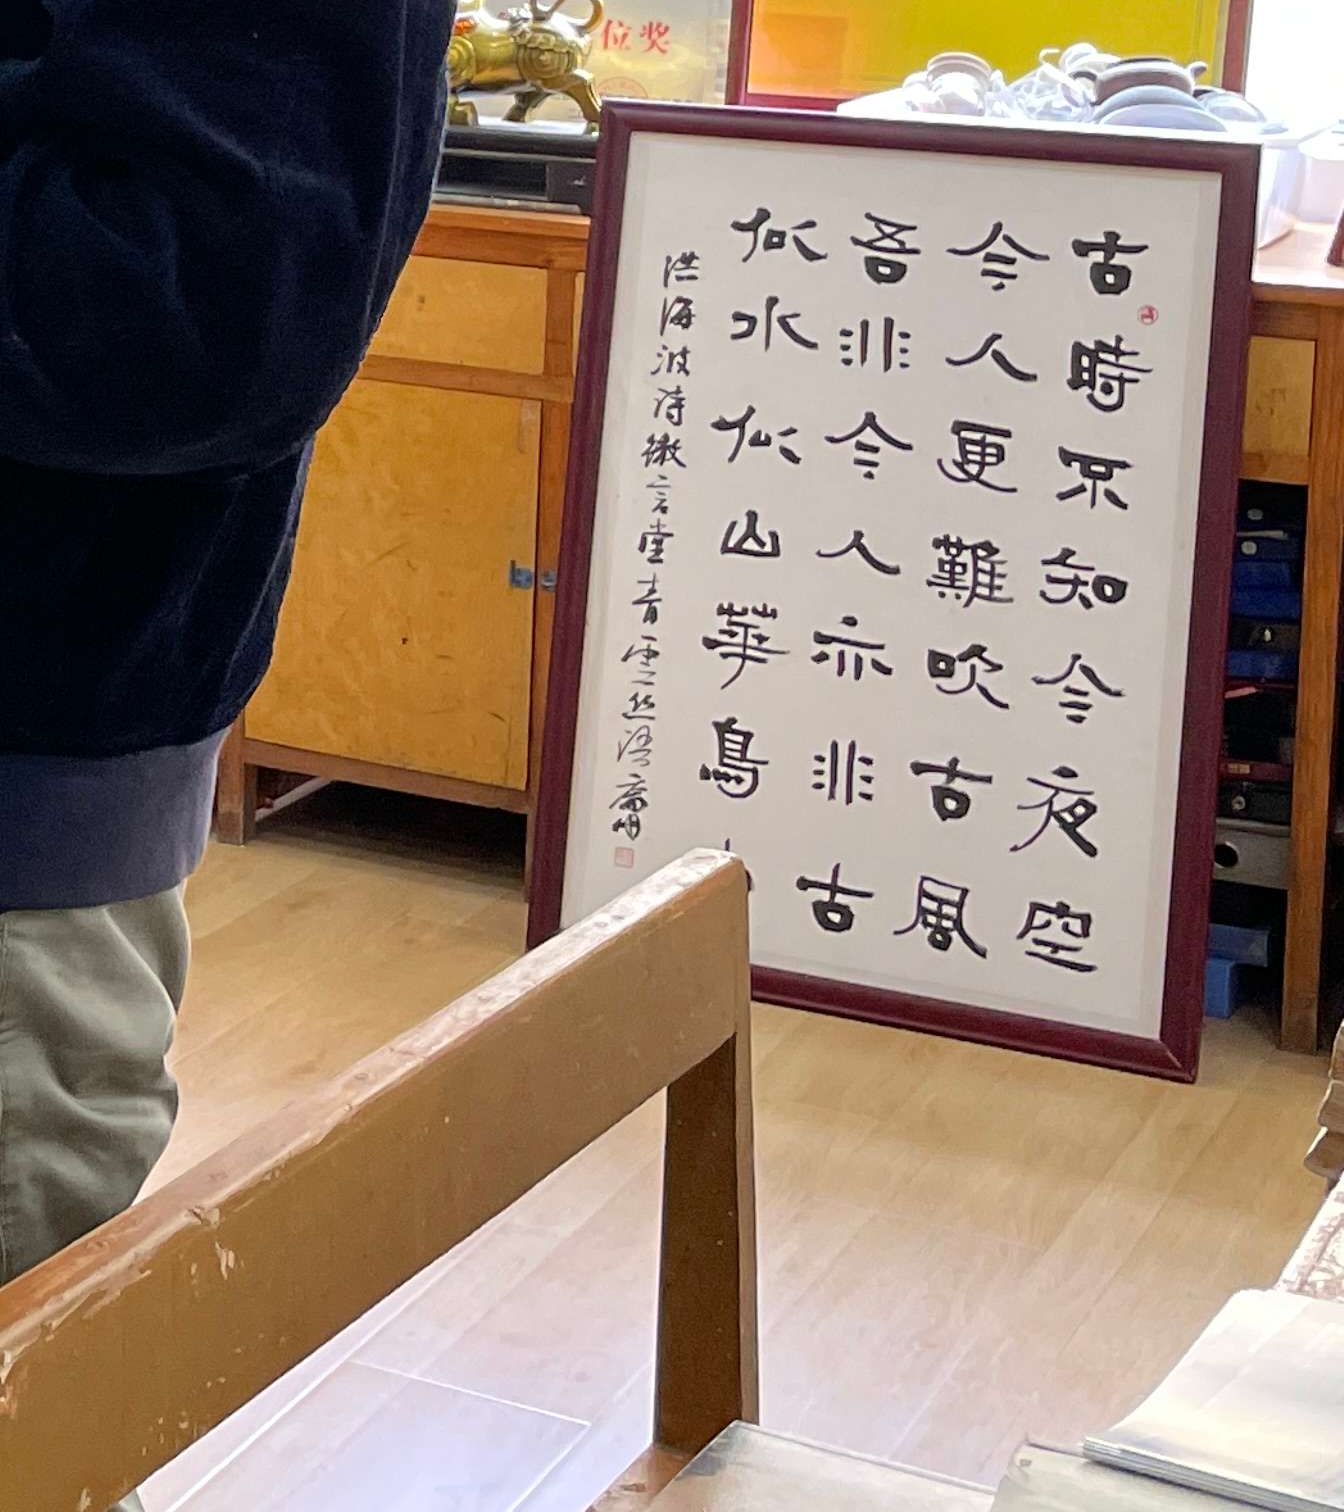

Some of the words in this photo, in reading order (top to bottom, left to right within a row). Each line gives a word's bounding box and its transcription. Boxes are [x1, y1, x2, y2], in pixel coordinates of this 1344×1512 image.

[601, 19, 672, 55] 位奖
[699, 207, 829, 893] 似水似山華鳥
